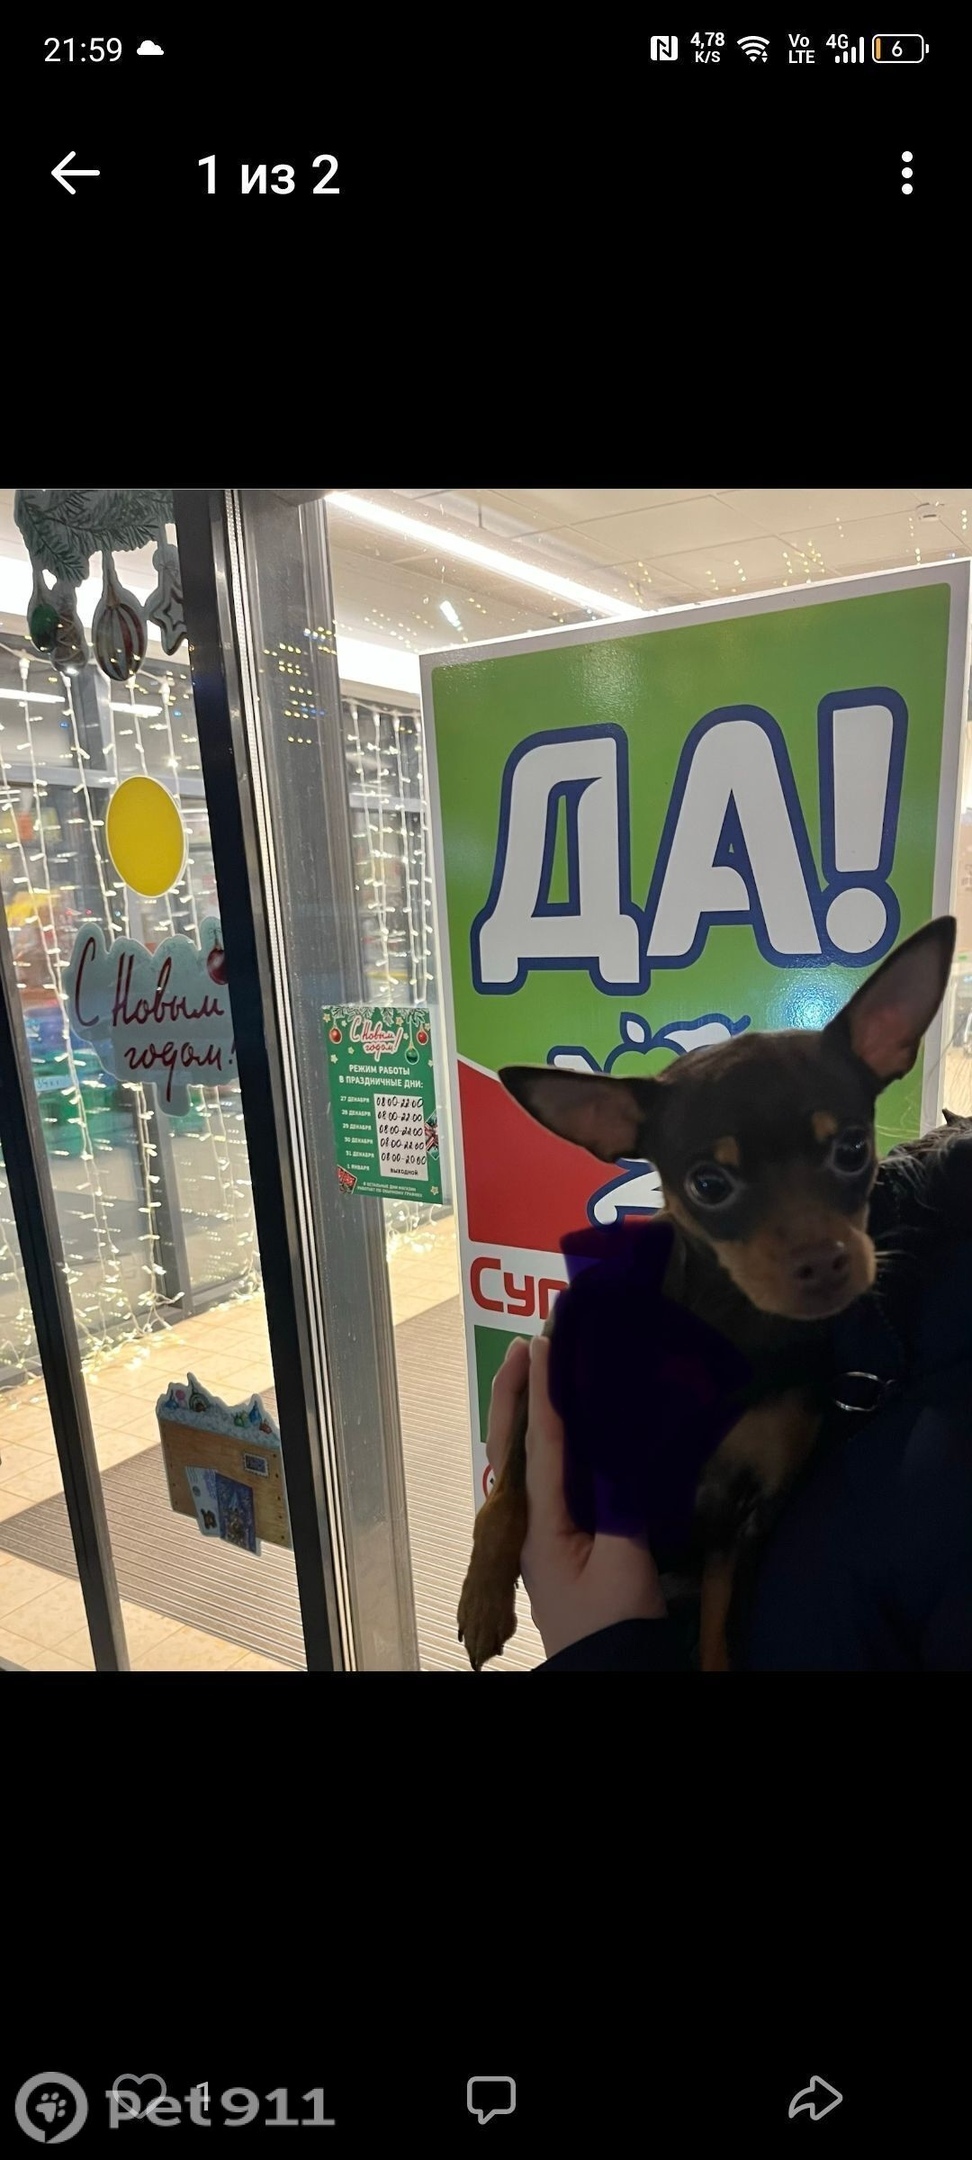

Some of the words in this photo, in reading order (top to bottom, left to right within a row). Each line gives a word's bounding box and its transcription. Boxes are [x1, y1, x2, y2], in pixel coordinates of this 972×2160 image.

[471, 687, 908, 996] ДА!
[75, 936, 99, 1027] С
[112, 952, 225, 1027] Новым
[350, 1015, 361, 1042] С
[361, 1019, 395, 1041] Новым
[349, 1064, 376, 1073] РЕЖИМ
[379, 1066, 410, 1075] РАБОТЫ
[339, 1075, 344, 1083] В
[346, 1076, 402, 1086] ПРАЗДНИЧНЫЕ
[404, 1080, 423, 1088] ДНИ:
[390, 1168, 418, 1176] ВЫХОДНОЙ
